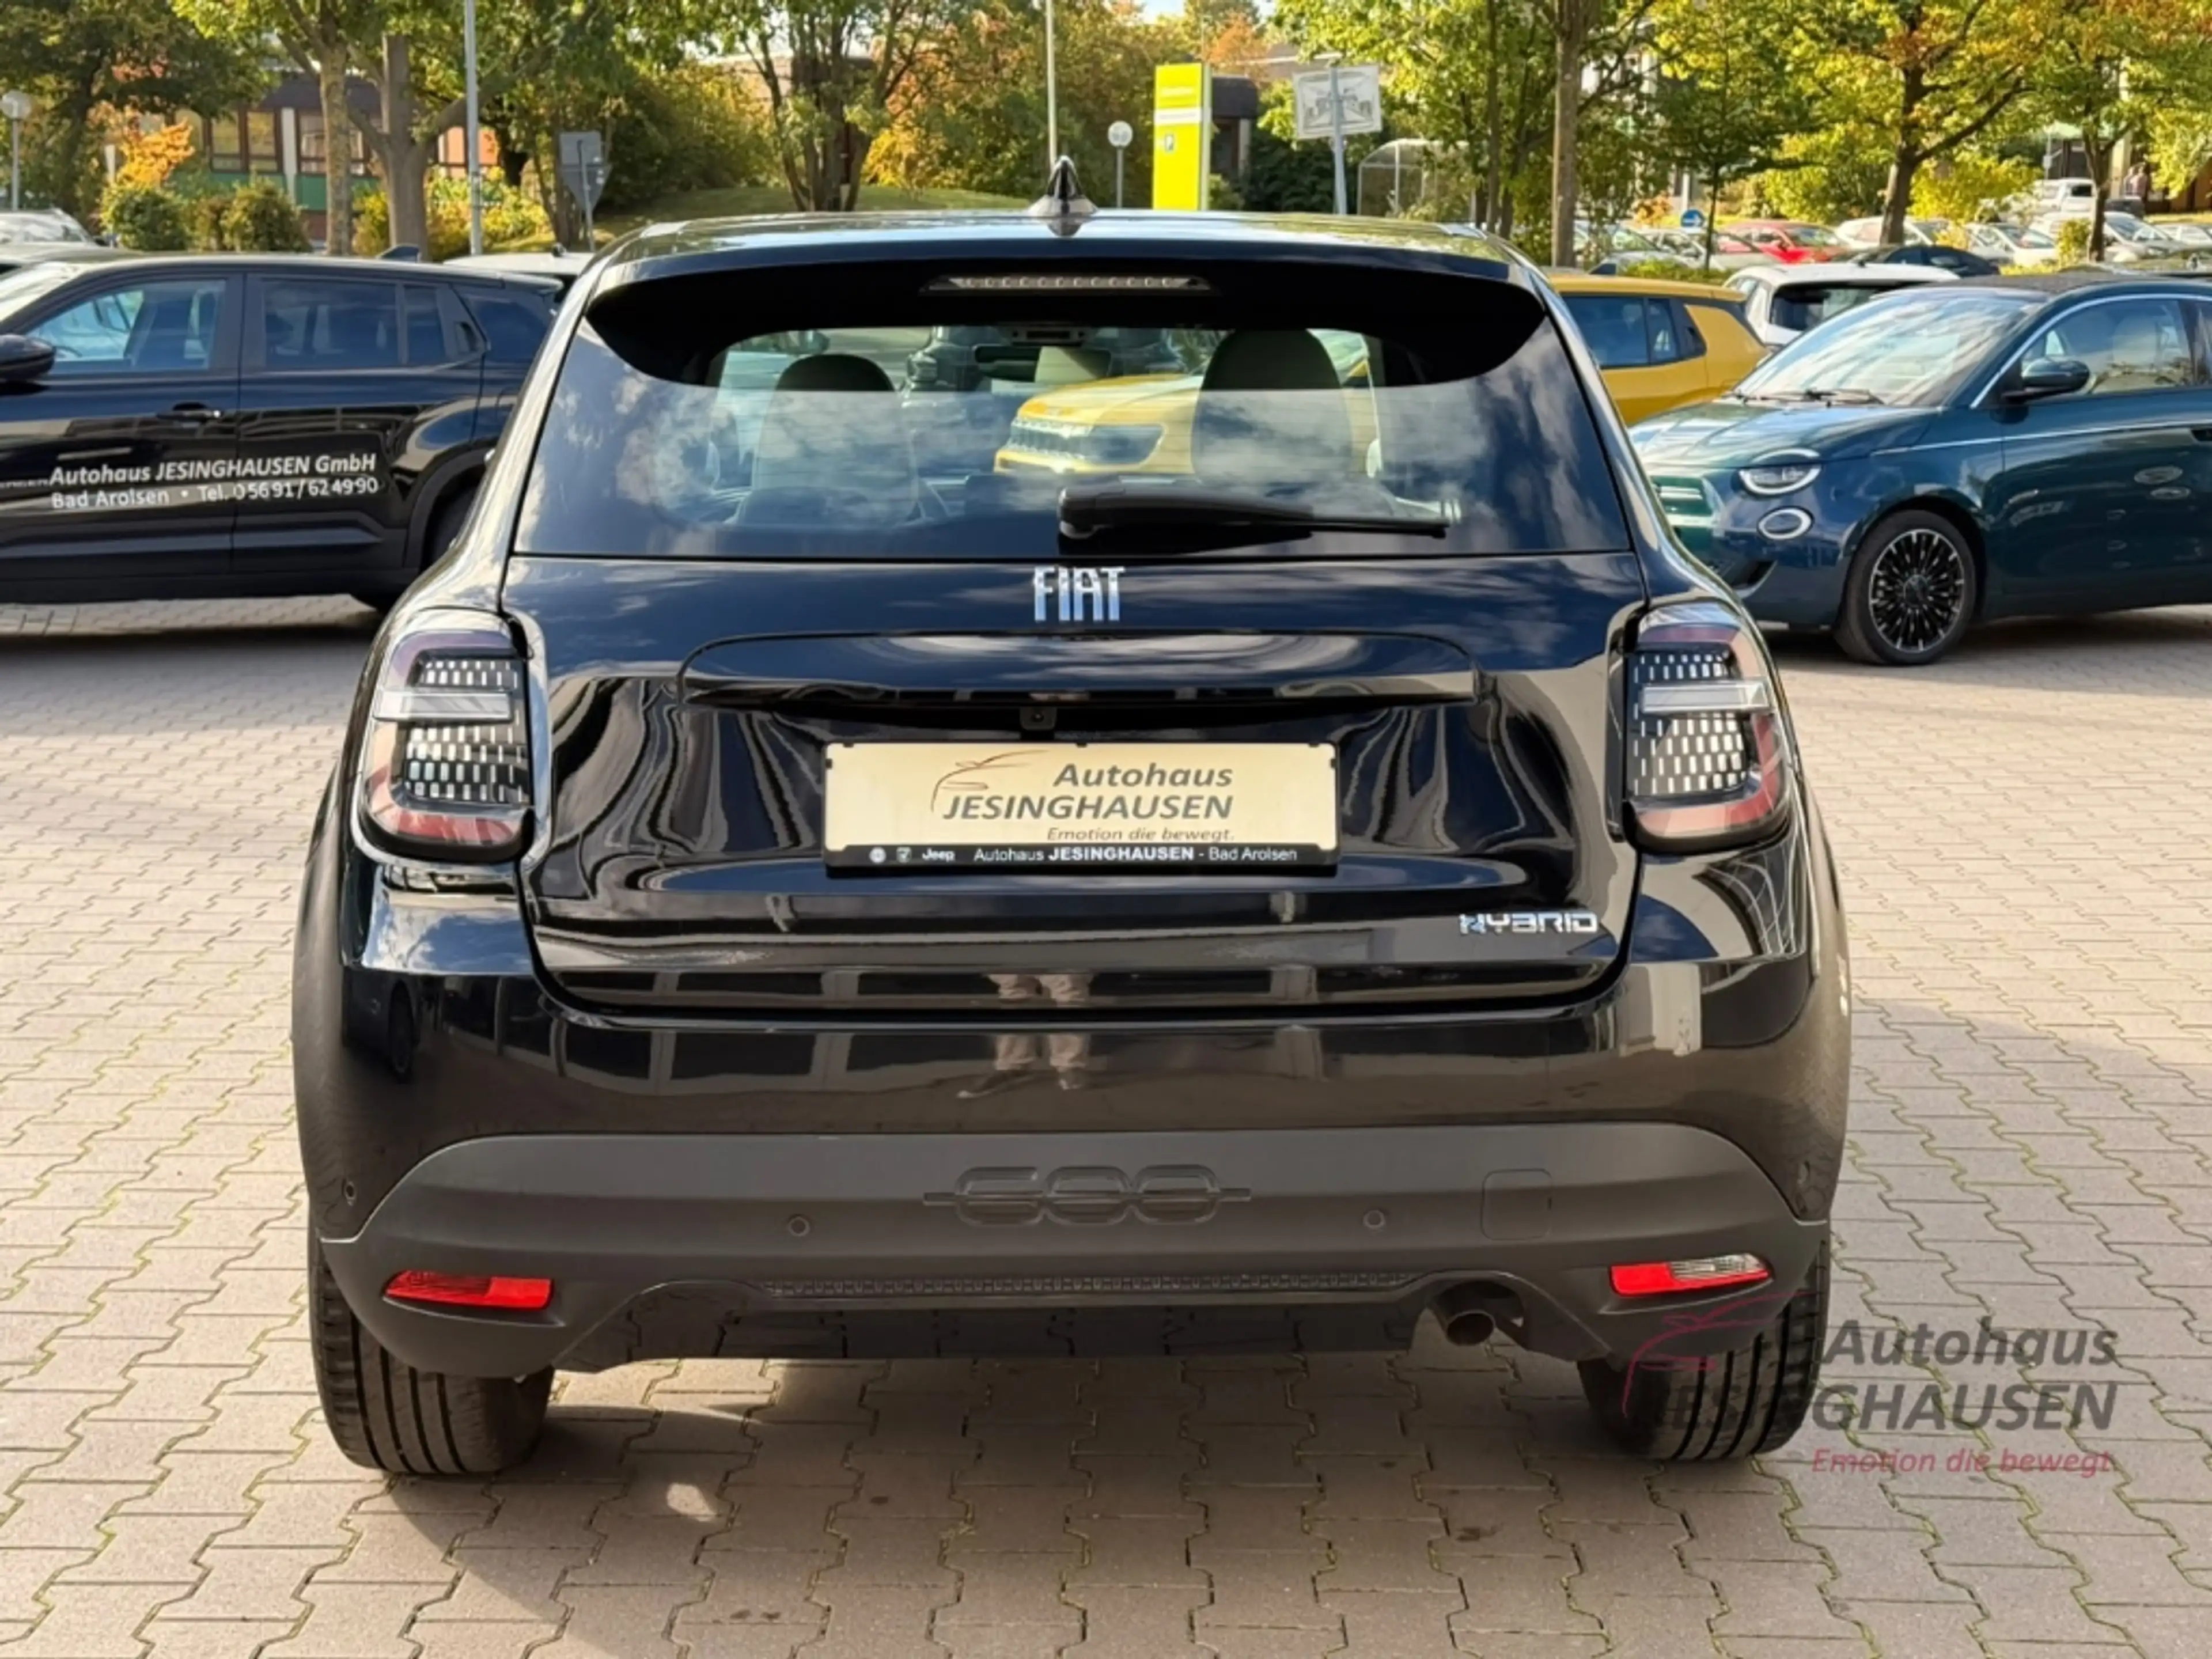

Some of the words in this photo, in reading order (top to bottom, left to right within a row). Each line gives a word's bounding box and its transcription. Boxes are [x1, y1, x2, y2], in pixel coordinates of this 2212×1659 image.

[50, 464, 151, 486] Autohaus
[156, 456, 310, 480] JESINGHAUSEN
[315, 453, 376, 474] GmbH
[51, 490, 88, 509] Bad
[94, 488, 169, 507] Arolsen
[1033, 566, 1126, 622] FIAT
[1052, 762, 1234, 787] Autohaus
[942, 794, 1234, 820] JESINGHAUSEN
[1047, 827, 1123, 841] Emotion
[1128, 827, 1157, 841] die
[922, 848, 956, 862] Jeep
[974, 847, 1044, 862] Autohaus
[1048, 846, 1194, 861] JESINGHAUSEN
[1209, 847, 1237, 861] Bad
[1241, 846, 1297, 861] Arolsen
[1459, 912, 1598, 934] HYBRID
